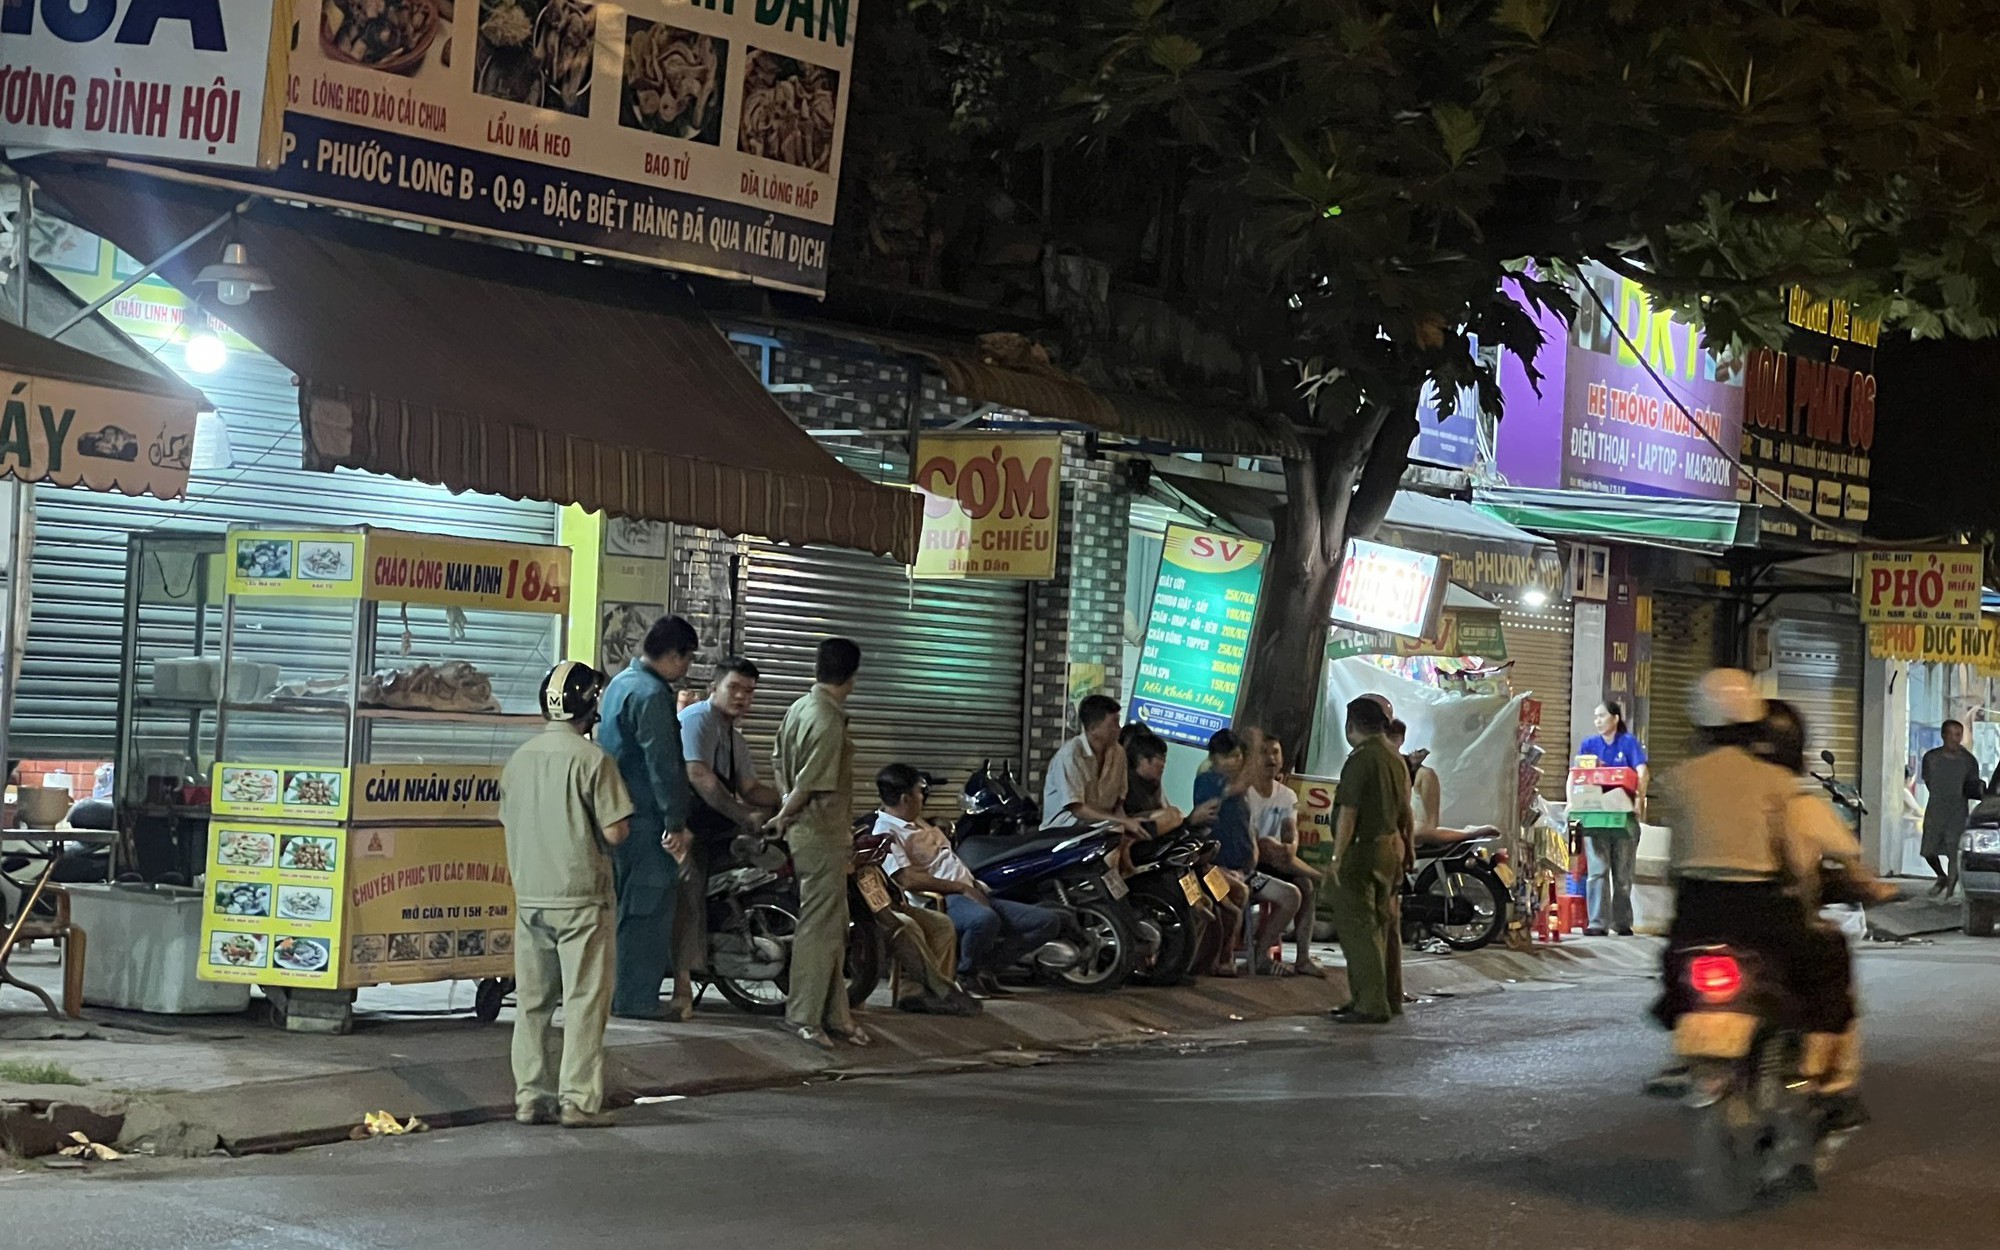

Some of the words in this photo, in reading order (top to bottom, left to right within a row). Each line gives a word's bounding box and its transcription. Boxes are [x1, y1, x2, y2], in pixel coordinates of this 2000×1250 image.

[85, 67, 171, 137] ĐÌNH
[179, 76, 240, 154] HỘI
[313, 73, 343, 110] LÒNG
[346, 87, 369, 115] HEO
[372, 86, 394, 121] XÀO
[418, 102, 446, 133] CHUA
[487, 111, 514, 147] LẨU
[518, 125, 539, 152] MÁ
[544, 132, 571, 158] HEO
[645, 152, 669, 177] BAO
[674, 151, 690, 181] TỬ
[317, 139, 393, 185] PHƯỚC
[398, 155, 453, 197] LONG
[459, 168, 473, 200] B
[493, 175, 526, 213] Q.9
[543, 181, 582, 227] ĐẶC
[587, 189, 628, 233] BIỆT
[633, 196, 677, 240] HÀNG
[682, 206, 705, 244] ĐÃ
[709, 216, 739, 252] QUA
[744, 214, 785, 260] KIỂM
[788, 234, 825, 271] DỊCH
[763, 172, 793, 201] LÒNG
[796, 181, 819, 210] HẤP
[1588, 379, 1607, 426] HỆ
[1610, 383, 1658, 430] THỐNG
[1661, 400, 1691, 438] MUA
[1693, 404, 1721, 444] BÁN
[1571, 422, 1596, 465] ĐIỆN
[1598, 432, 1630, 472] THOẠI
[1638, 441, 1677, 476] LAPTOP
[1685, 451, 1732, 487] MACBOOK
[917, 445, 1053, 519] CƠM
[1190, 536, 1244, 562] SV
[1475, 550, 1538, 587] PHƯƠNG
[444, 562, 472, 592] NAM
[506, 559, 561, 603] 18A
[1870, 553, 1945, 608] PHỞ
[1611, 671, 1628, 693] MUA
[365, 769, 400, 802] CẢM
[452, 774, 476, 809] SỰ
[352, 872, 395, 907] CHUYÊN
[444, 860, 464, 881] CÁC
[463, 906, 481, 918] 15H
